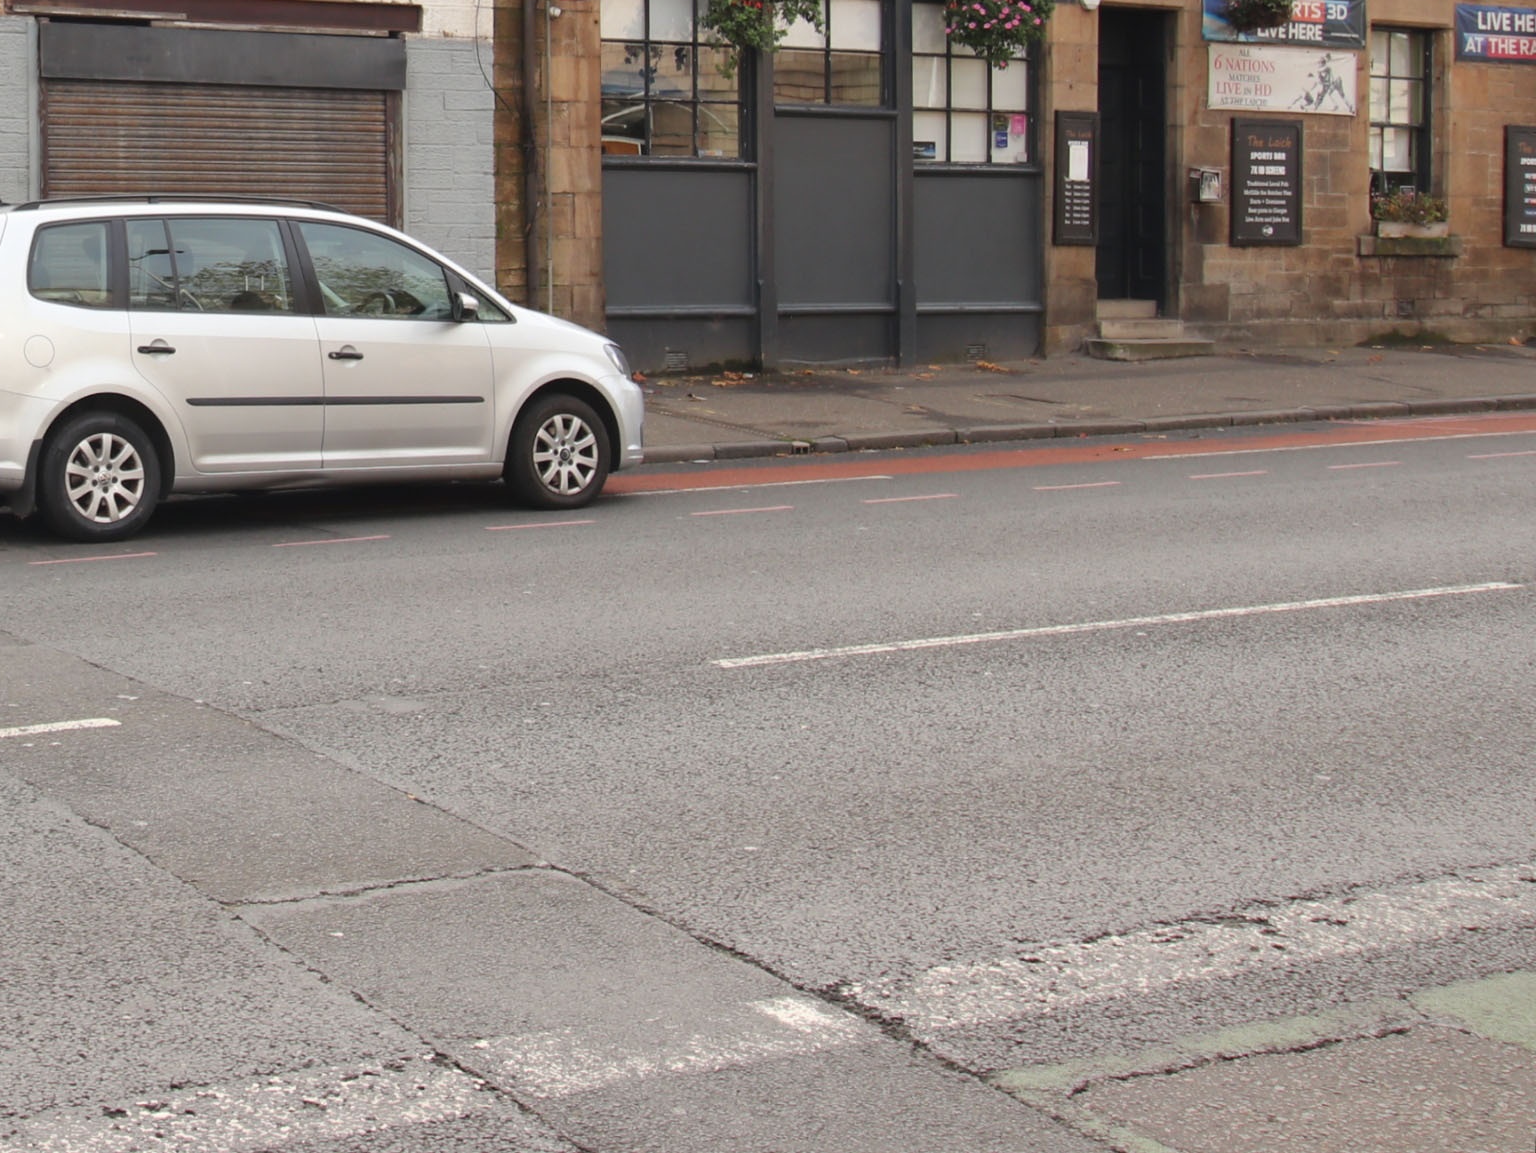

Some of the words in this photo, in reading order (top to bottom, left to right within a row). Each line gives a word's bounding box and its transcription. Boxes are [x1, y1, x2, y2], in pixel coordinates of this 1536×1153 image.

[1326, 3, 1348, 21] 3D
[1477, 11, 1512, 32] LIVE
[1514, 13, 1536, 33] HE
[1288, 22, 1324, 41] HERE
[1238, 48, 1252, 58] ALL
[1464, 36, 1484, 53] AT
[1488, 37, 1518, 55] THE
[1214, 53, 1224, 70] 6
[1225, 57, 1276, 73] NATIONS
[1228, 73, 1261, 83] MATCHES
[1216, 81, 1241, 96] LIVE
[1243, 87, 1252, 96] IN
[1254, 83, 1272, 97] HD
[1247, 134, 1264, 147] The
[1268, 135, 1294, 148] Laich
